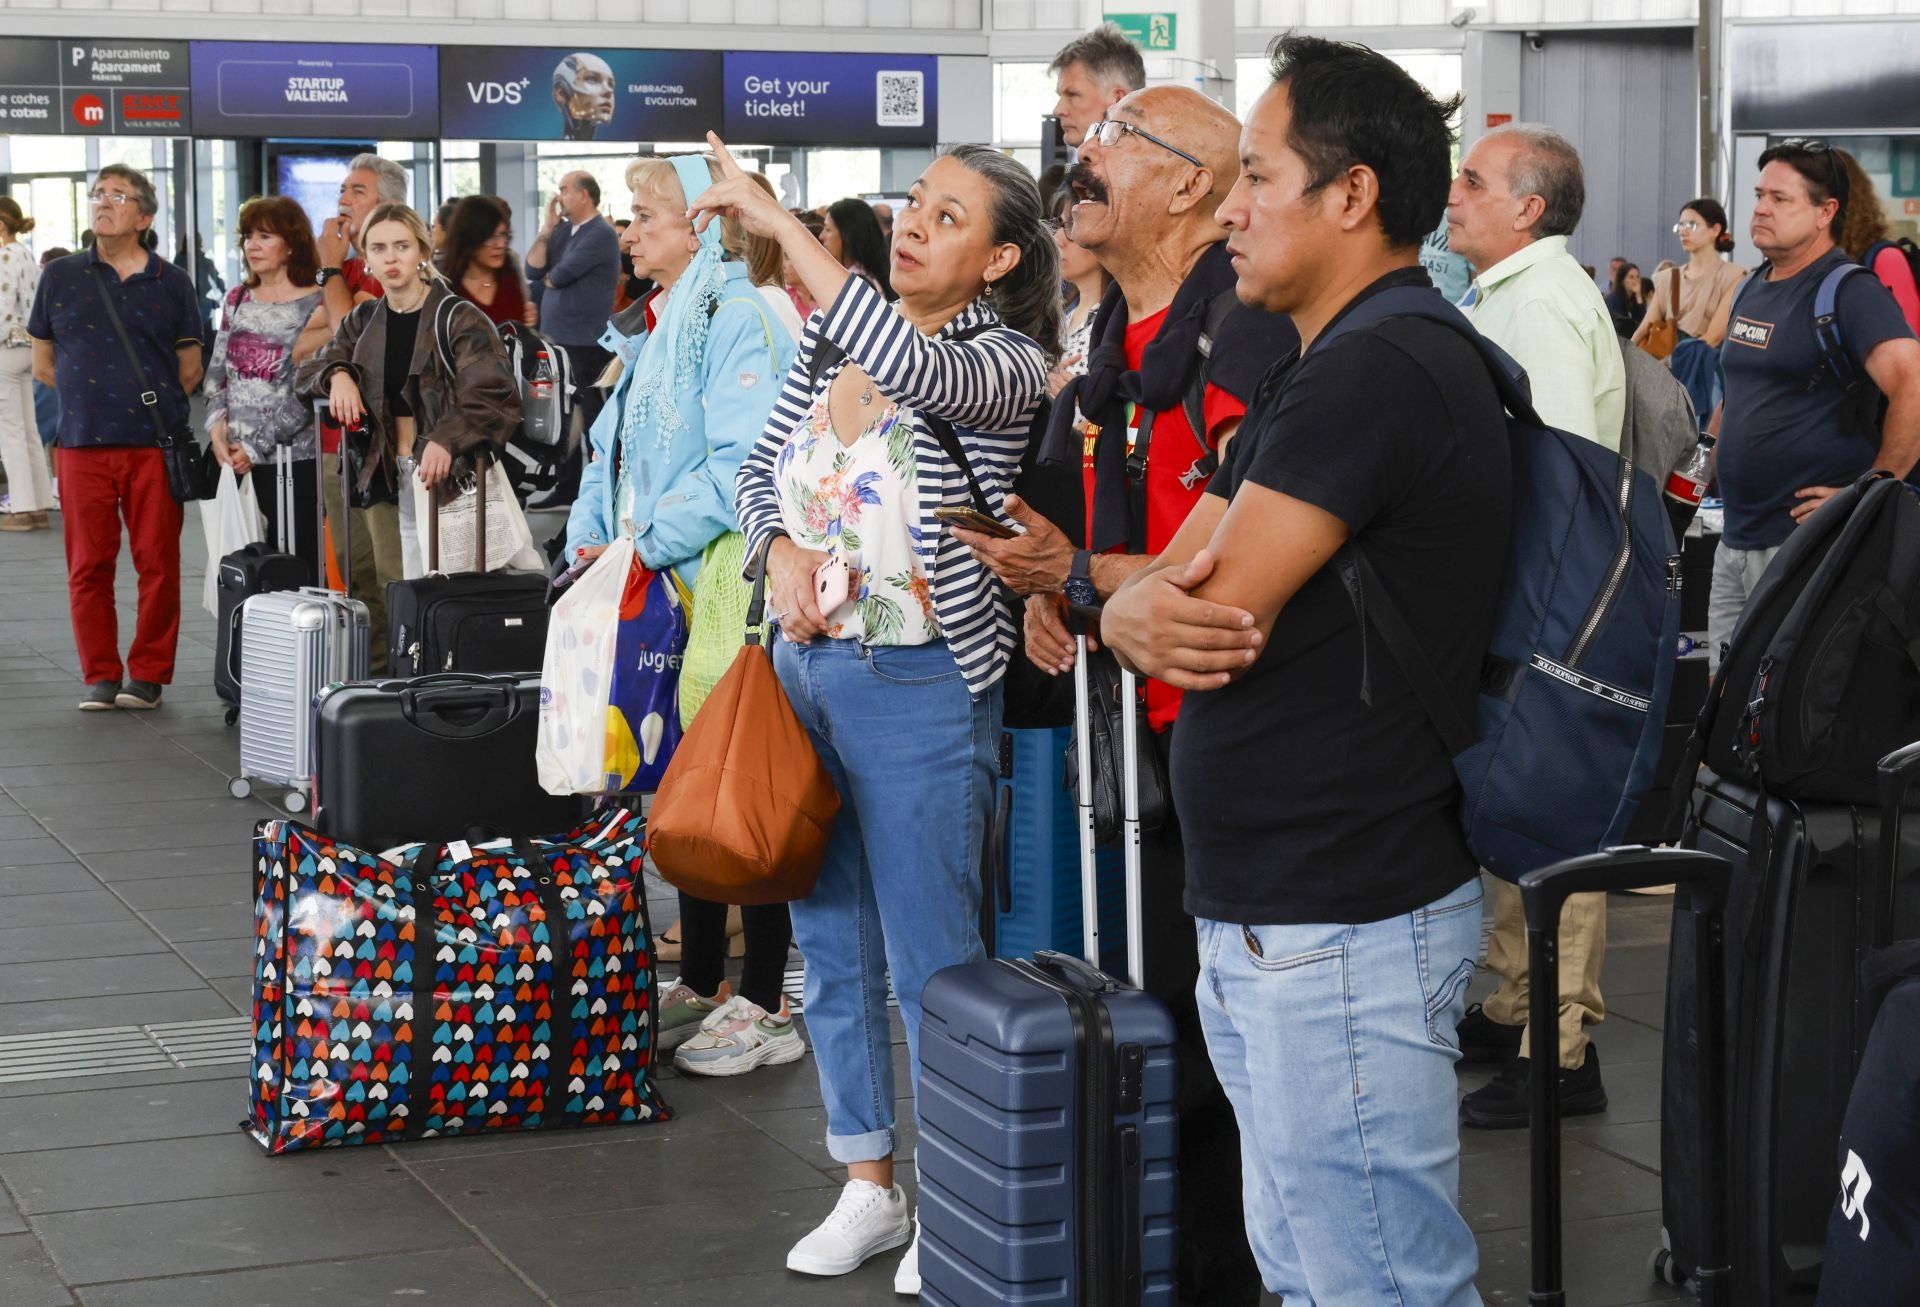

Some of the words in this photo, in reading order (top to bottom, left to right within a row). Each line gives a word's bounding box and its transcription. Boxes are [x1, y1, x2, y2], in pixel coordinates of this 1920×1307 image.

[72, 47, 85, 66] P
[91, 47, 170, 61] Aparcamiento
[91, 61, 162, 74] Aparcament
[288, 77, 344, 90] STARTUP
[628, 84, 684, 94] EMBRACING
[744, 76, 781, 94] Get
[787, 80, 830, 98] your
[10, 92, 50, 105] coches
[123, 95, 181, 108] EMT
[285, 89, 348, 102] VALENCIA
[645, 97, 697, 106] EVOLUTION
[10, 107, 48, 118] cotxes
[84, 106, 104, 121] m
[745, 99, 805, 117] ticket!
[1733, 321, 1748, 336] RIP
[1746, 325, 1768, 342] CURL
[1537, 660, 1555, 673] SOLO
[1555, 667, 1581, 685] SOPRANI
[1612, 692, 1630, 704] SOLO
